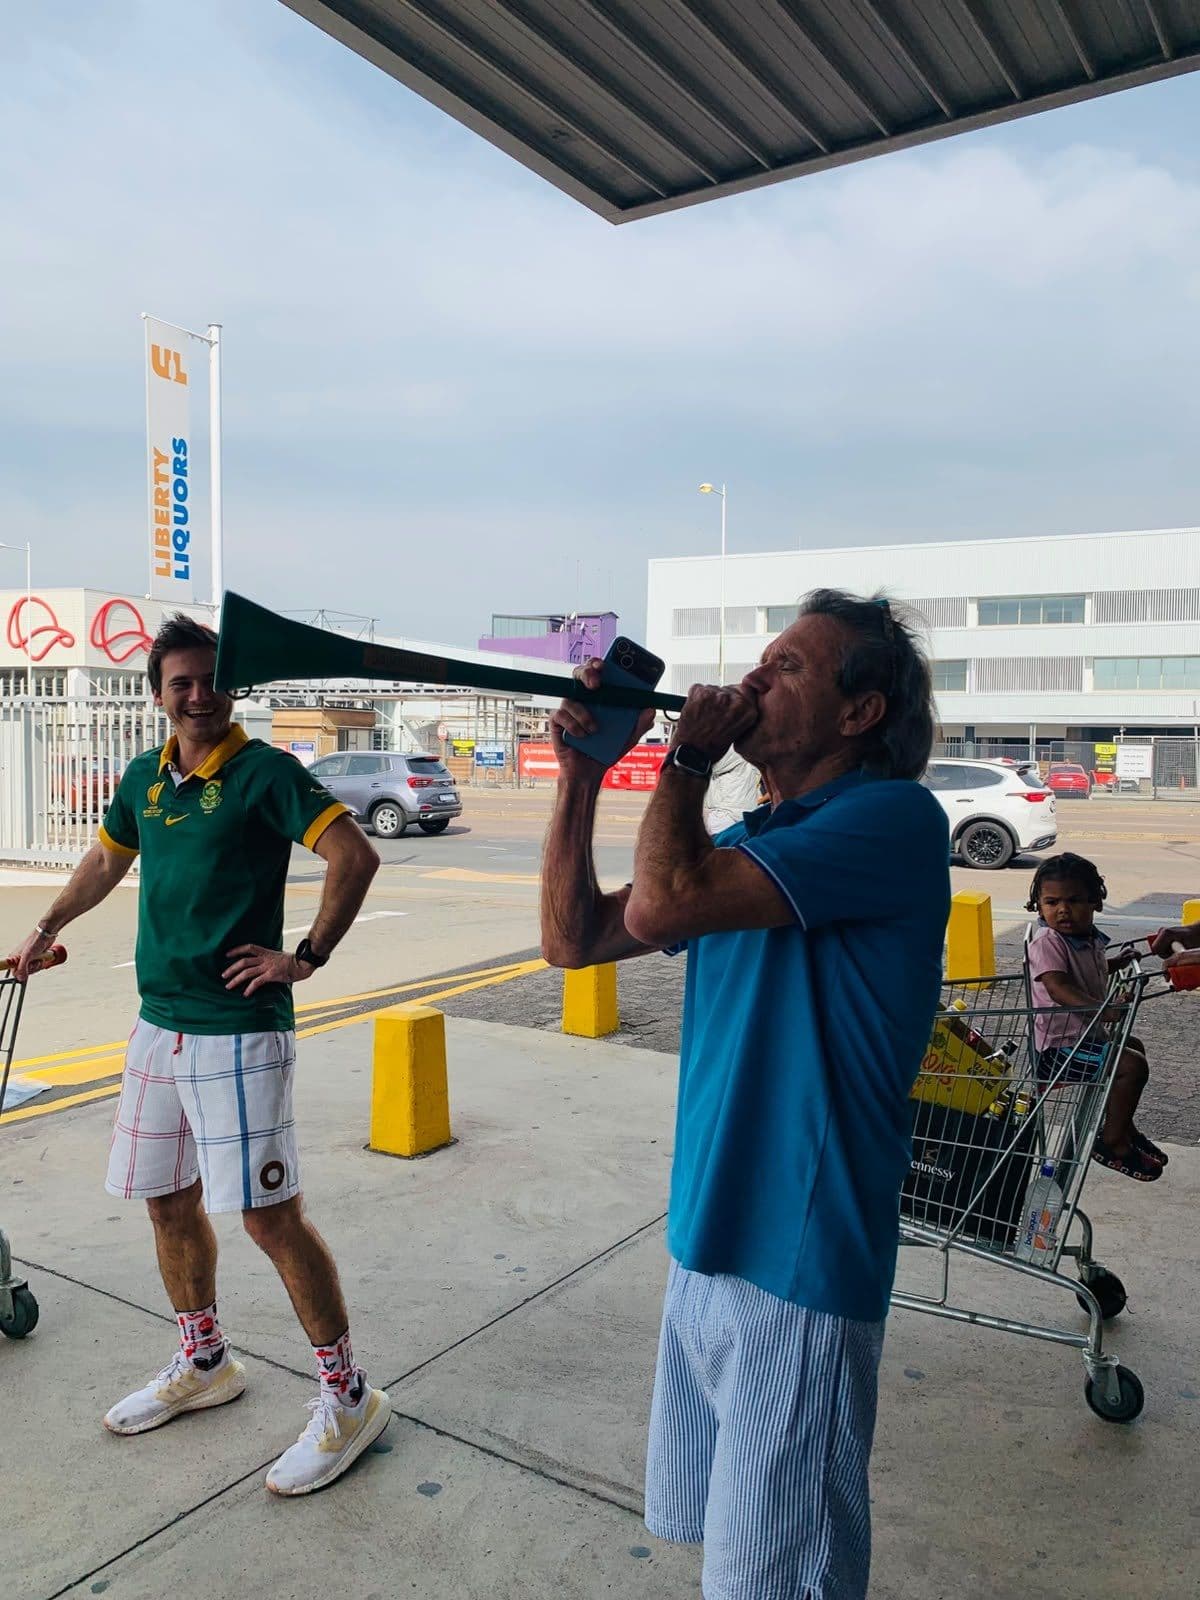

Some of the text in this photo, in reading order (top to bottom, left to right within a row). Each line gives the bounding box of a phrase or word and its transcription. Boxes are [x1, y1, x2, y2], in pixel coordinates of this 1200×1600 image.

[154, 447, 171, 577] LIBERTY
[172, 437, 190, 580] LIQUORS
[910, 1159, 956, 1182] ennessy
